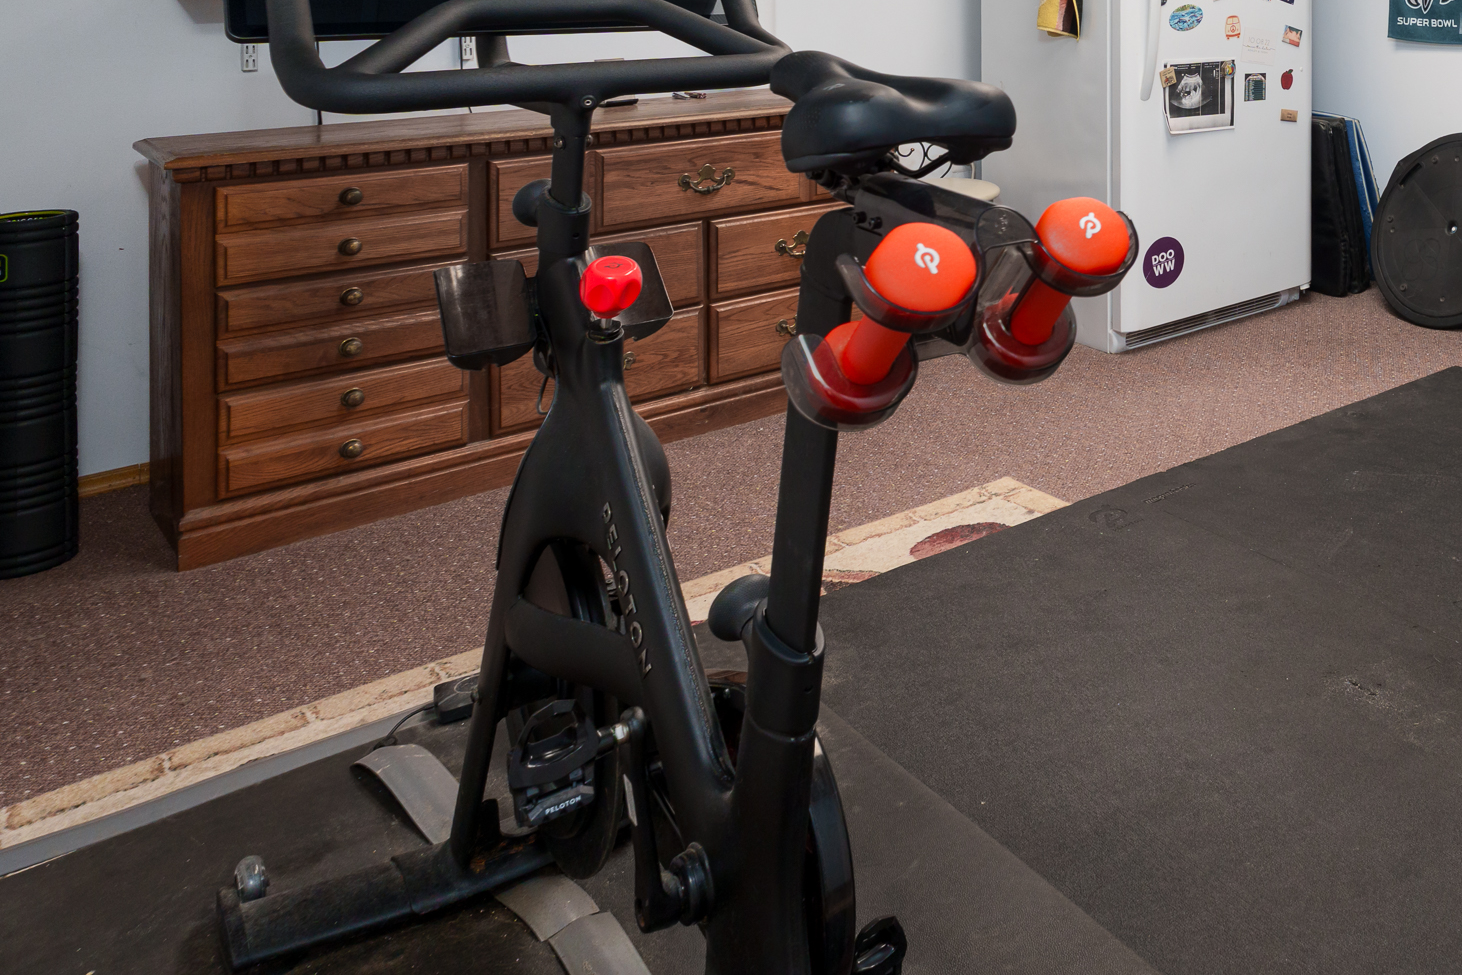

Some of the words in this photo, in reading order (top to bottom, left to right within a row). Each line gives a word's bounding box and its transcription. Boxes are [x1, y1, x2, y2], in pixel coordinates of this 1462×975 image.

[1397, 17, 1429, 26] SUPER
[1431, 18, 1457, 27] BOWL
[1151, 249, 1175, 265] DOO
[602, 502, 652, 677] PELOTON
[545, 795, 582, 815] PELOTON
